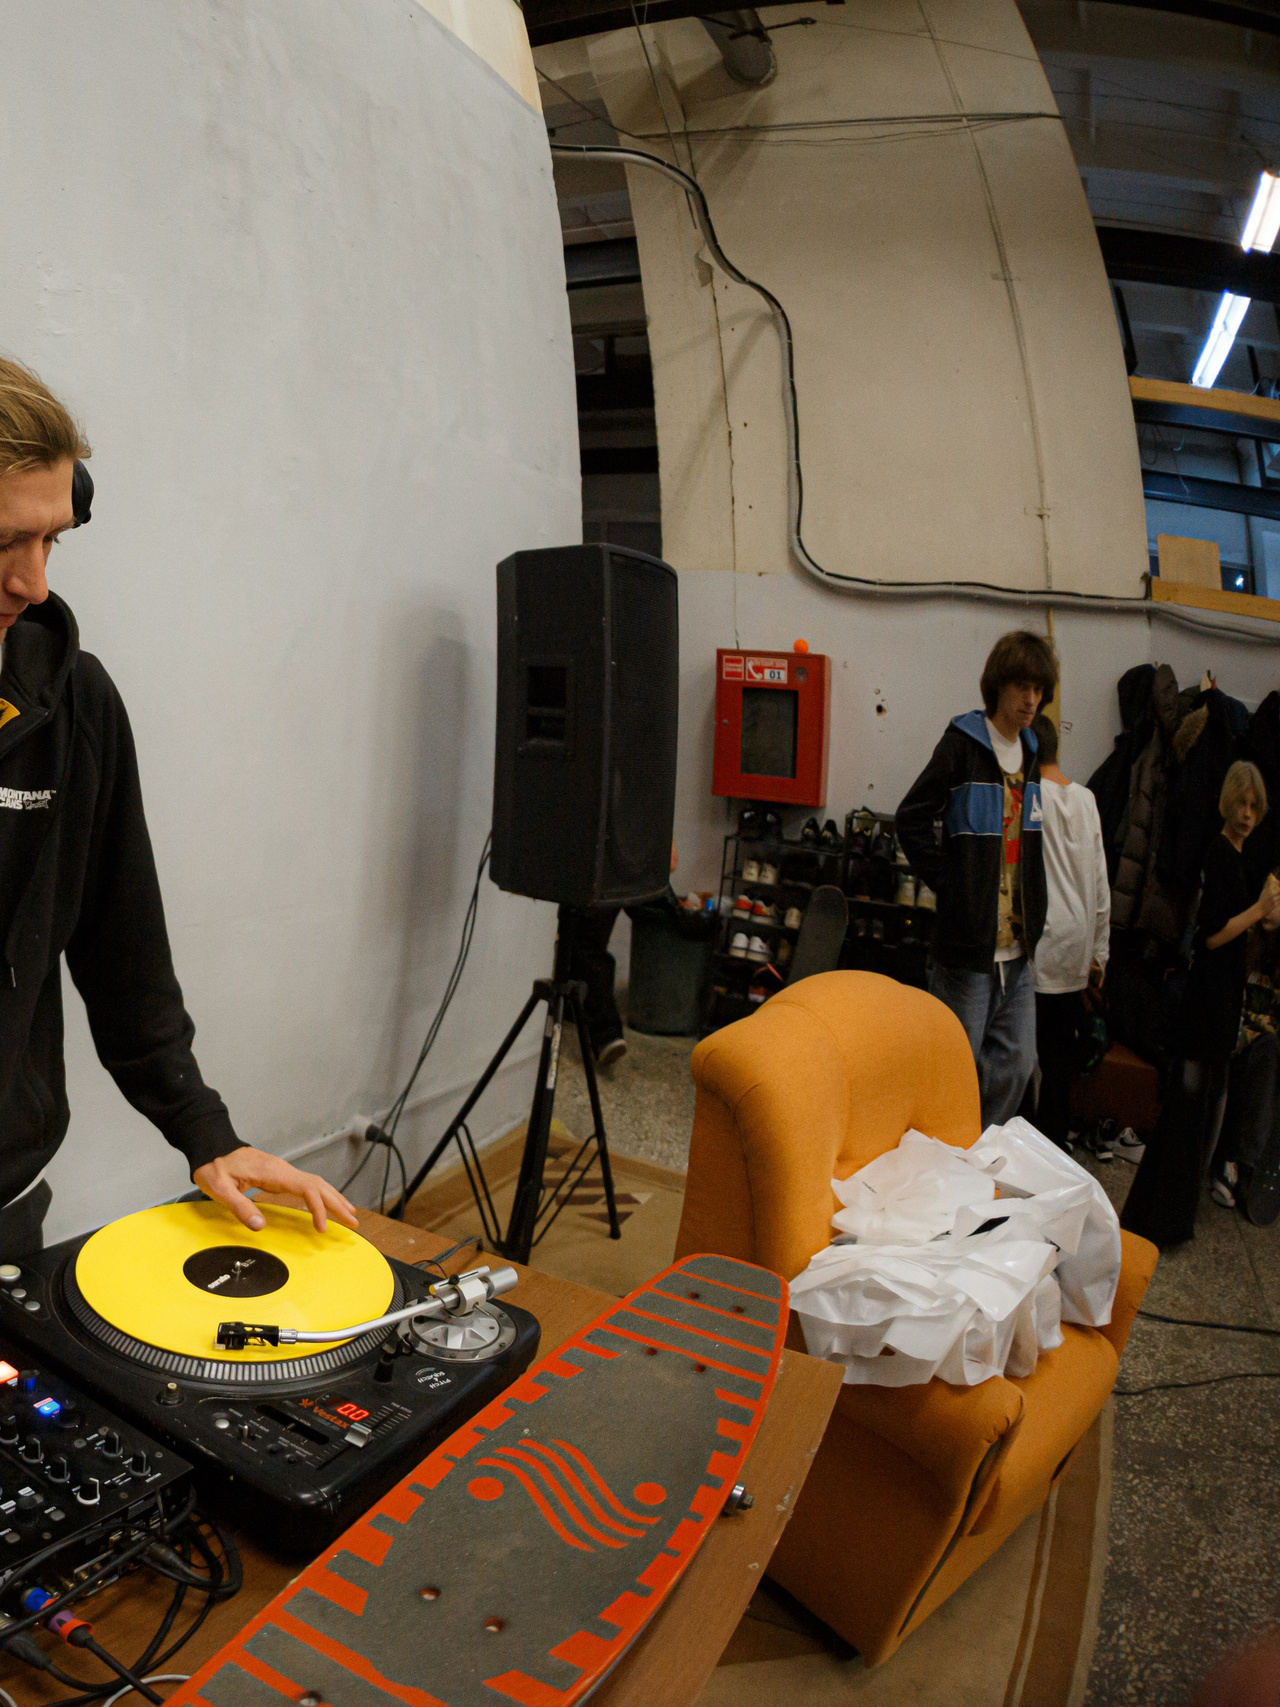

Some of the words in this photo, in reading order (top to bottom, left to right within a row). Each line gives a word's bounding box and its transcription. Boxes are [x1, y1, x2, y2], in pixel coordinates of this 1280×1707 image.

[769, 670, 781, 679] 01
[312, 1406, 350, 1429] Vestax
[336, 1402, 370, 1422] 0.0
